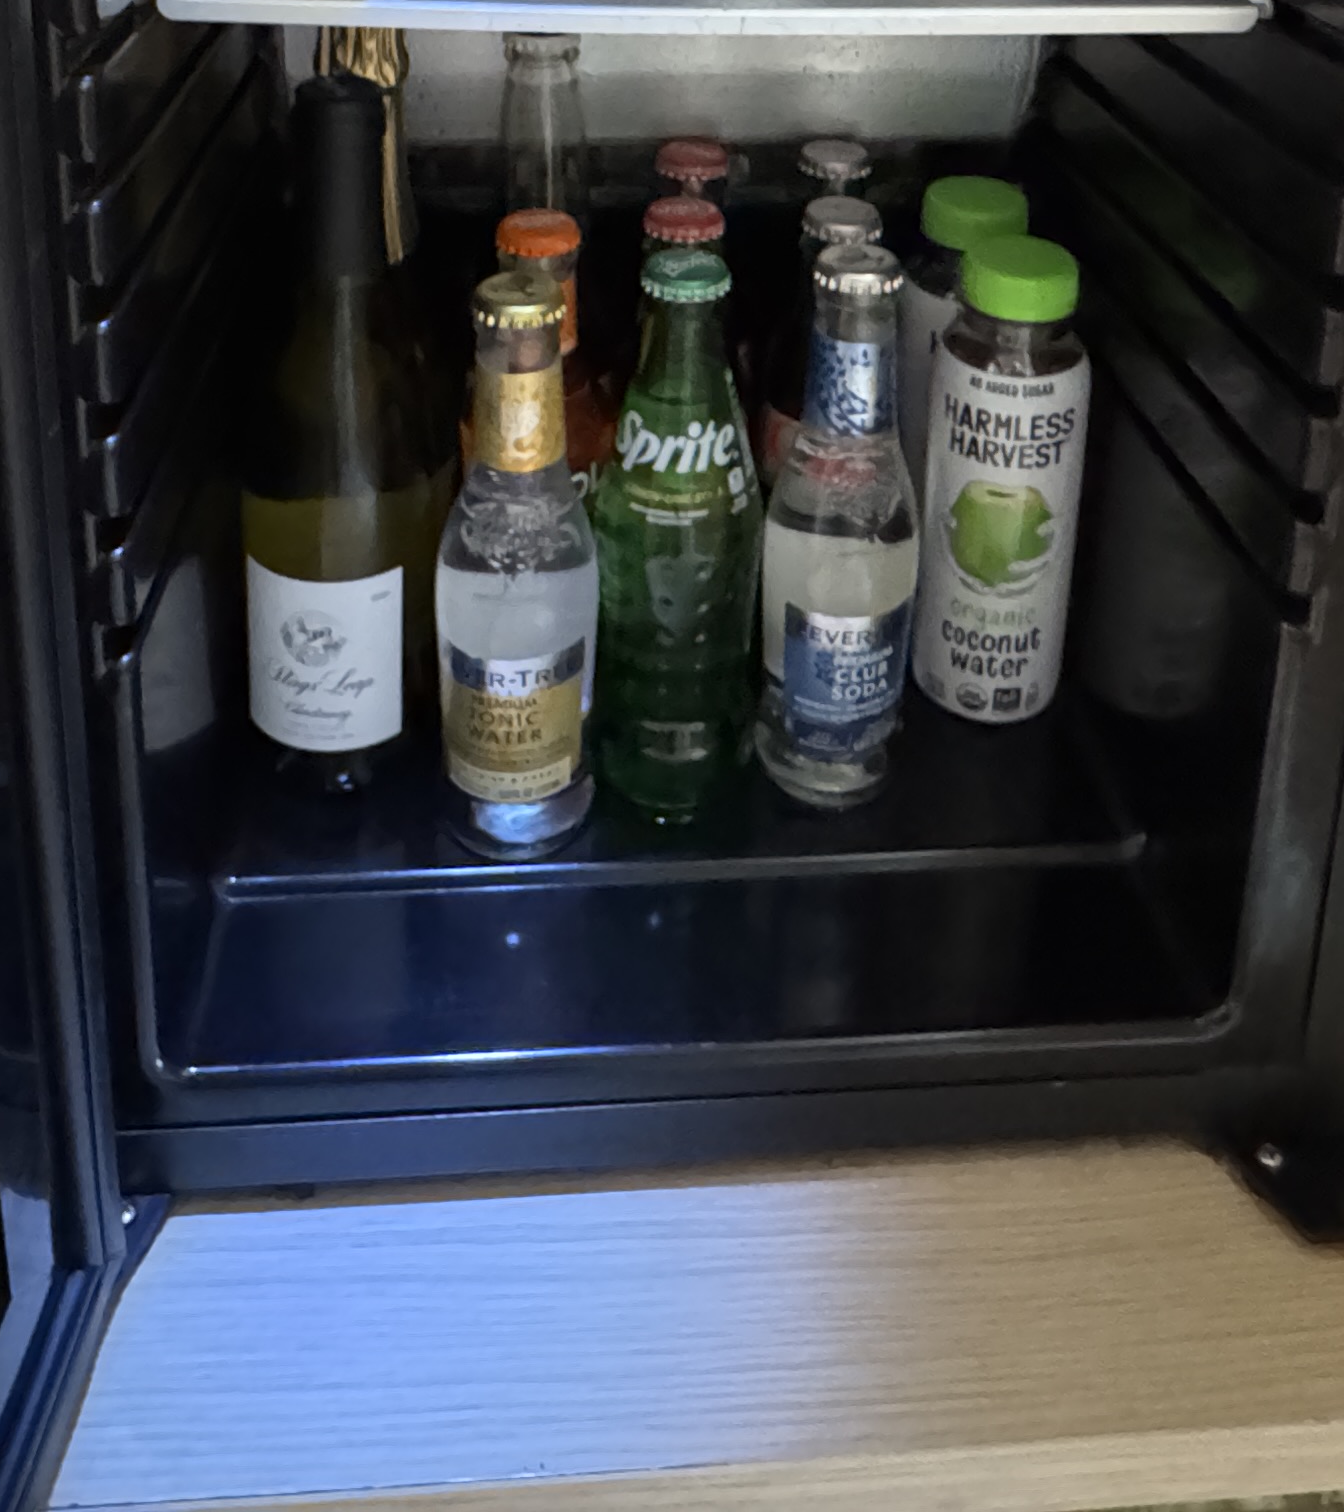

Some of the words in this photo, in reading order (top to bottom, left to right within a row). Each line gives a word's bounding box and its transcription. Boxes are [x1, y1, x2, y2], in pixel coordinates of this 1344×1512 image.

[944, 393, 1077, 442] HARMLESS
[615, 409, 736, 474] Sprite
[949, 428, 1066, 470] HARVEST
[941, 619, 1042, 654] coconut
[950, 647, 1029, 679] water
[469, 705, 540, 728] TONIC
